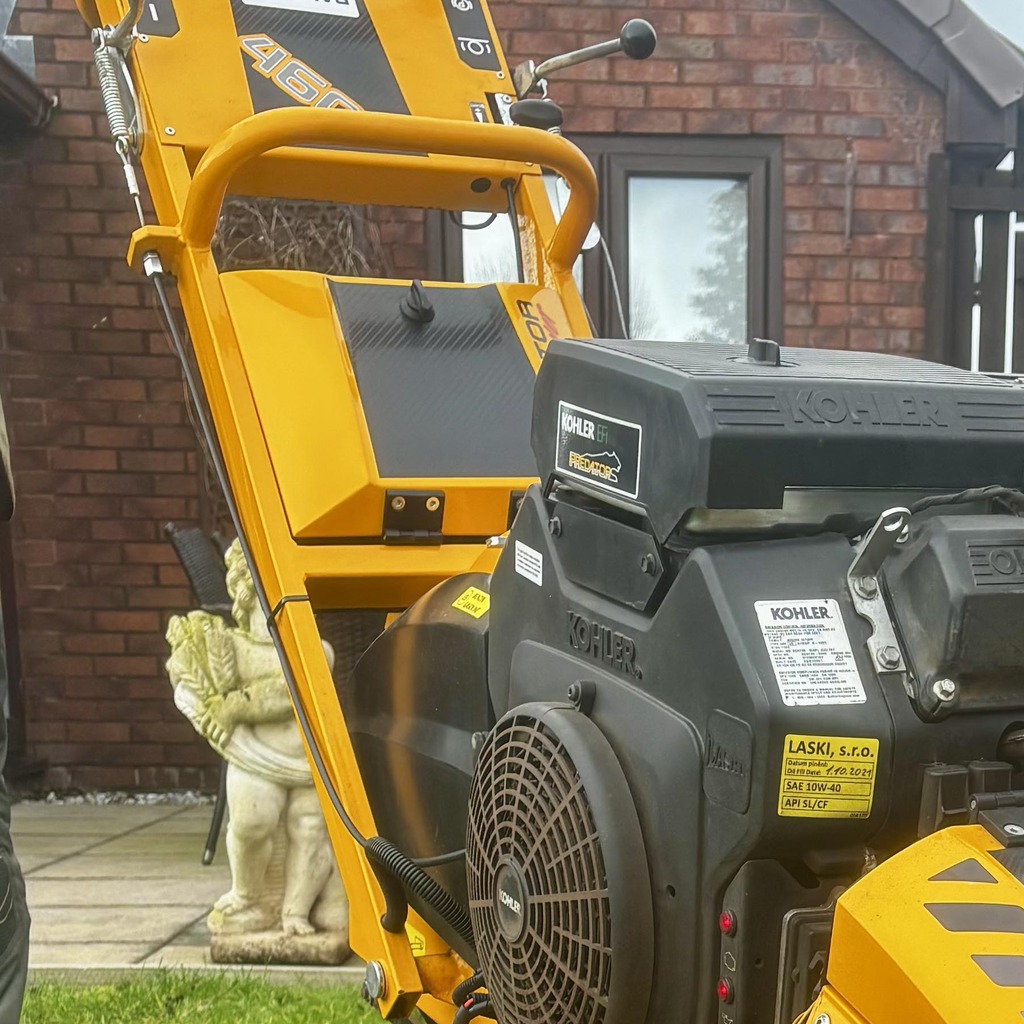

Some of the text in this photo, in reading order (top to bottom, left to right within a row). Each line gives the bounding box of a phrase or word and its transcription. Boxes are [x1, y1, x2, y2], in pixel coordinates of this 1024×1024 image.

[787, 388, 948, 428] KOHLER
[562, 412, 595, 440] KOHLER
[788, 739, 874, 758] LASKI, s.r.o.
[786, 781, 841, 792] SAE 10W-40
[785, 799, 829, 810] API SL/CF
